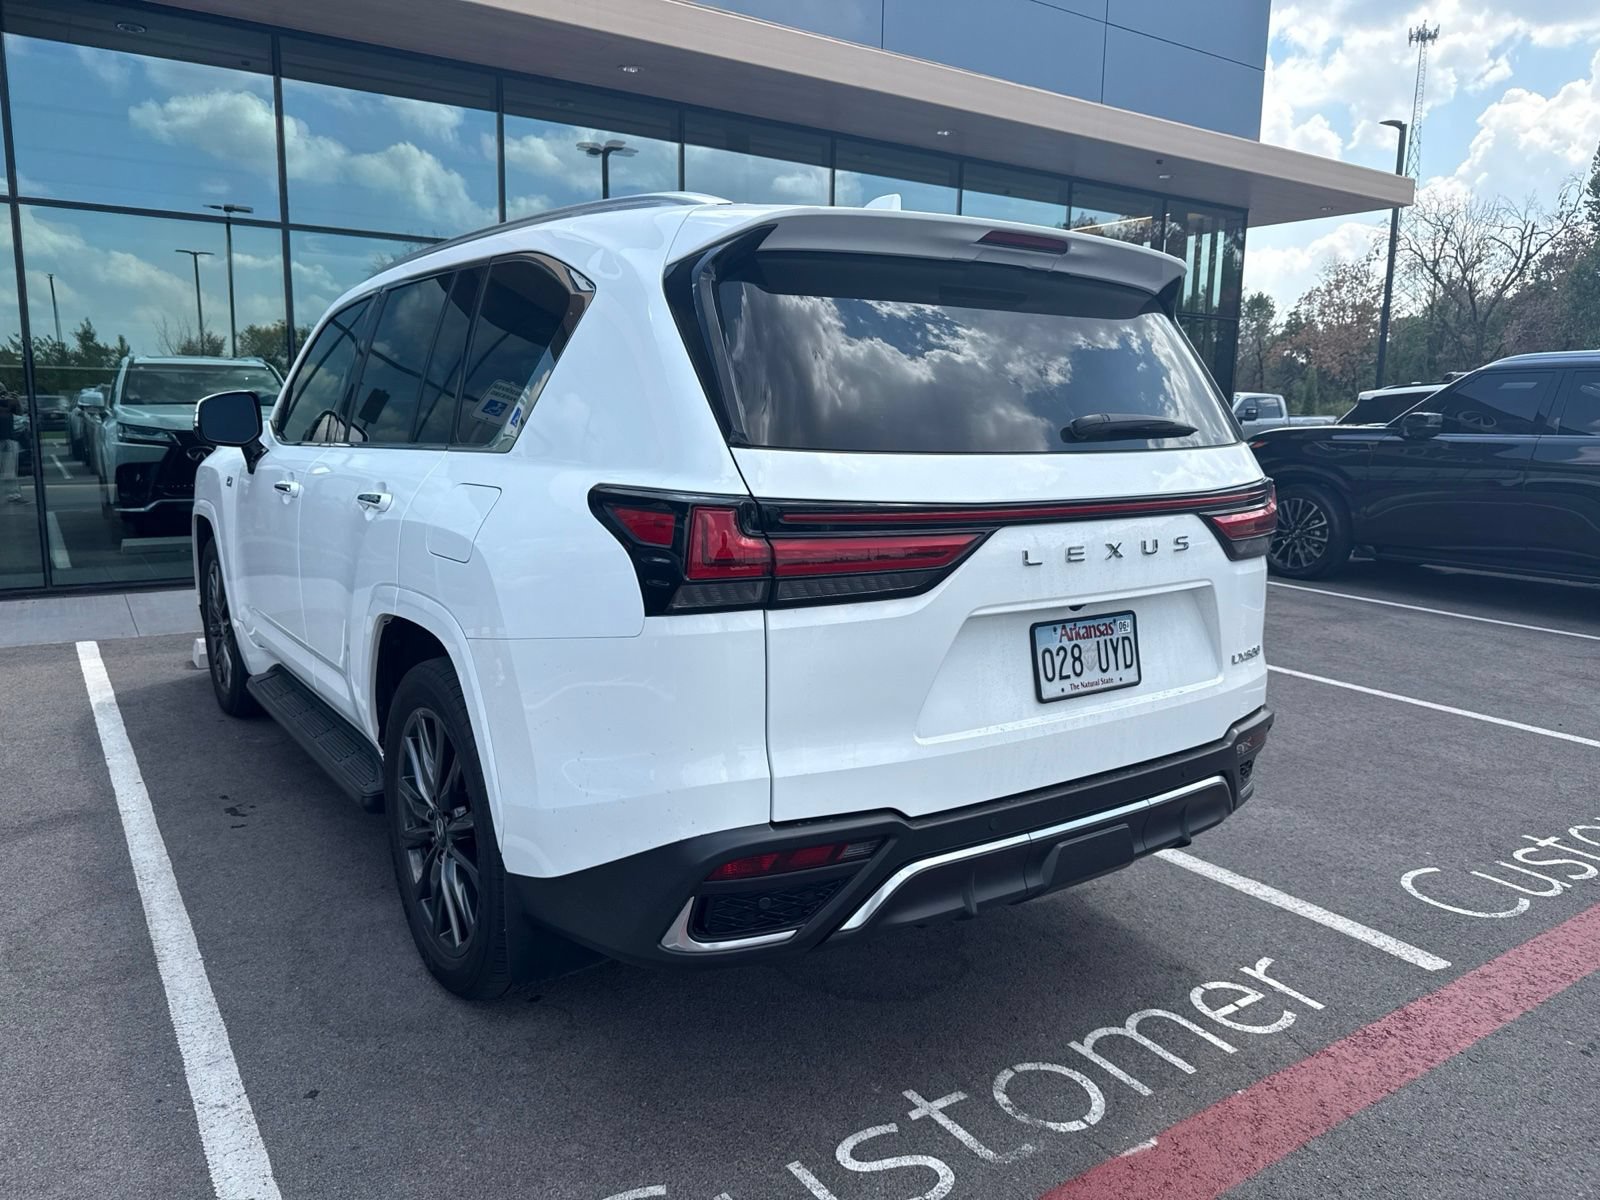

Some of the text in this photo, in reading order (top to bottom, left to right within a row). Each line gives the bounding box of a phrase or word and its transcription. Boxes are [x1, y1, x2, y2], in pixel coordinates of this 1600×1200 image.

[1022, 535, 1190, 566] LEXUS
[1059, 622, 1114, 643] Arkansas
[1041, 636, 1134, 682] 028 UYD
[1080, 679, 1100, 688] Natural
[1101, 677, 1114, 685] State
